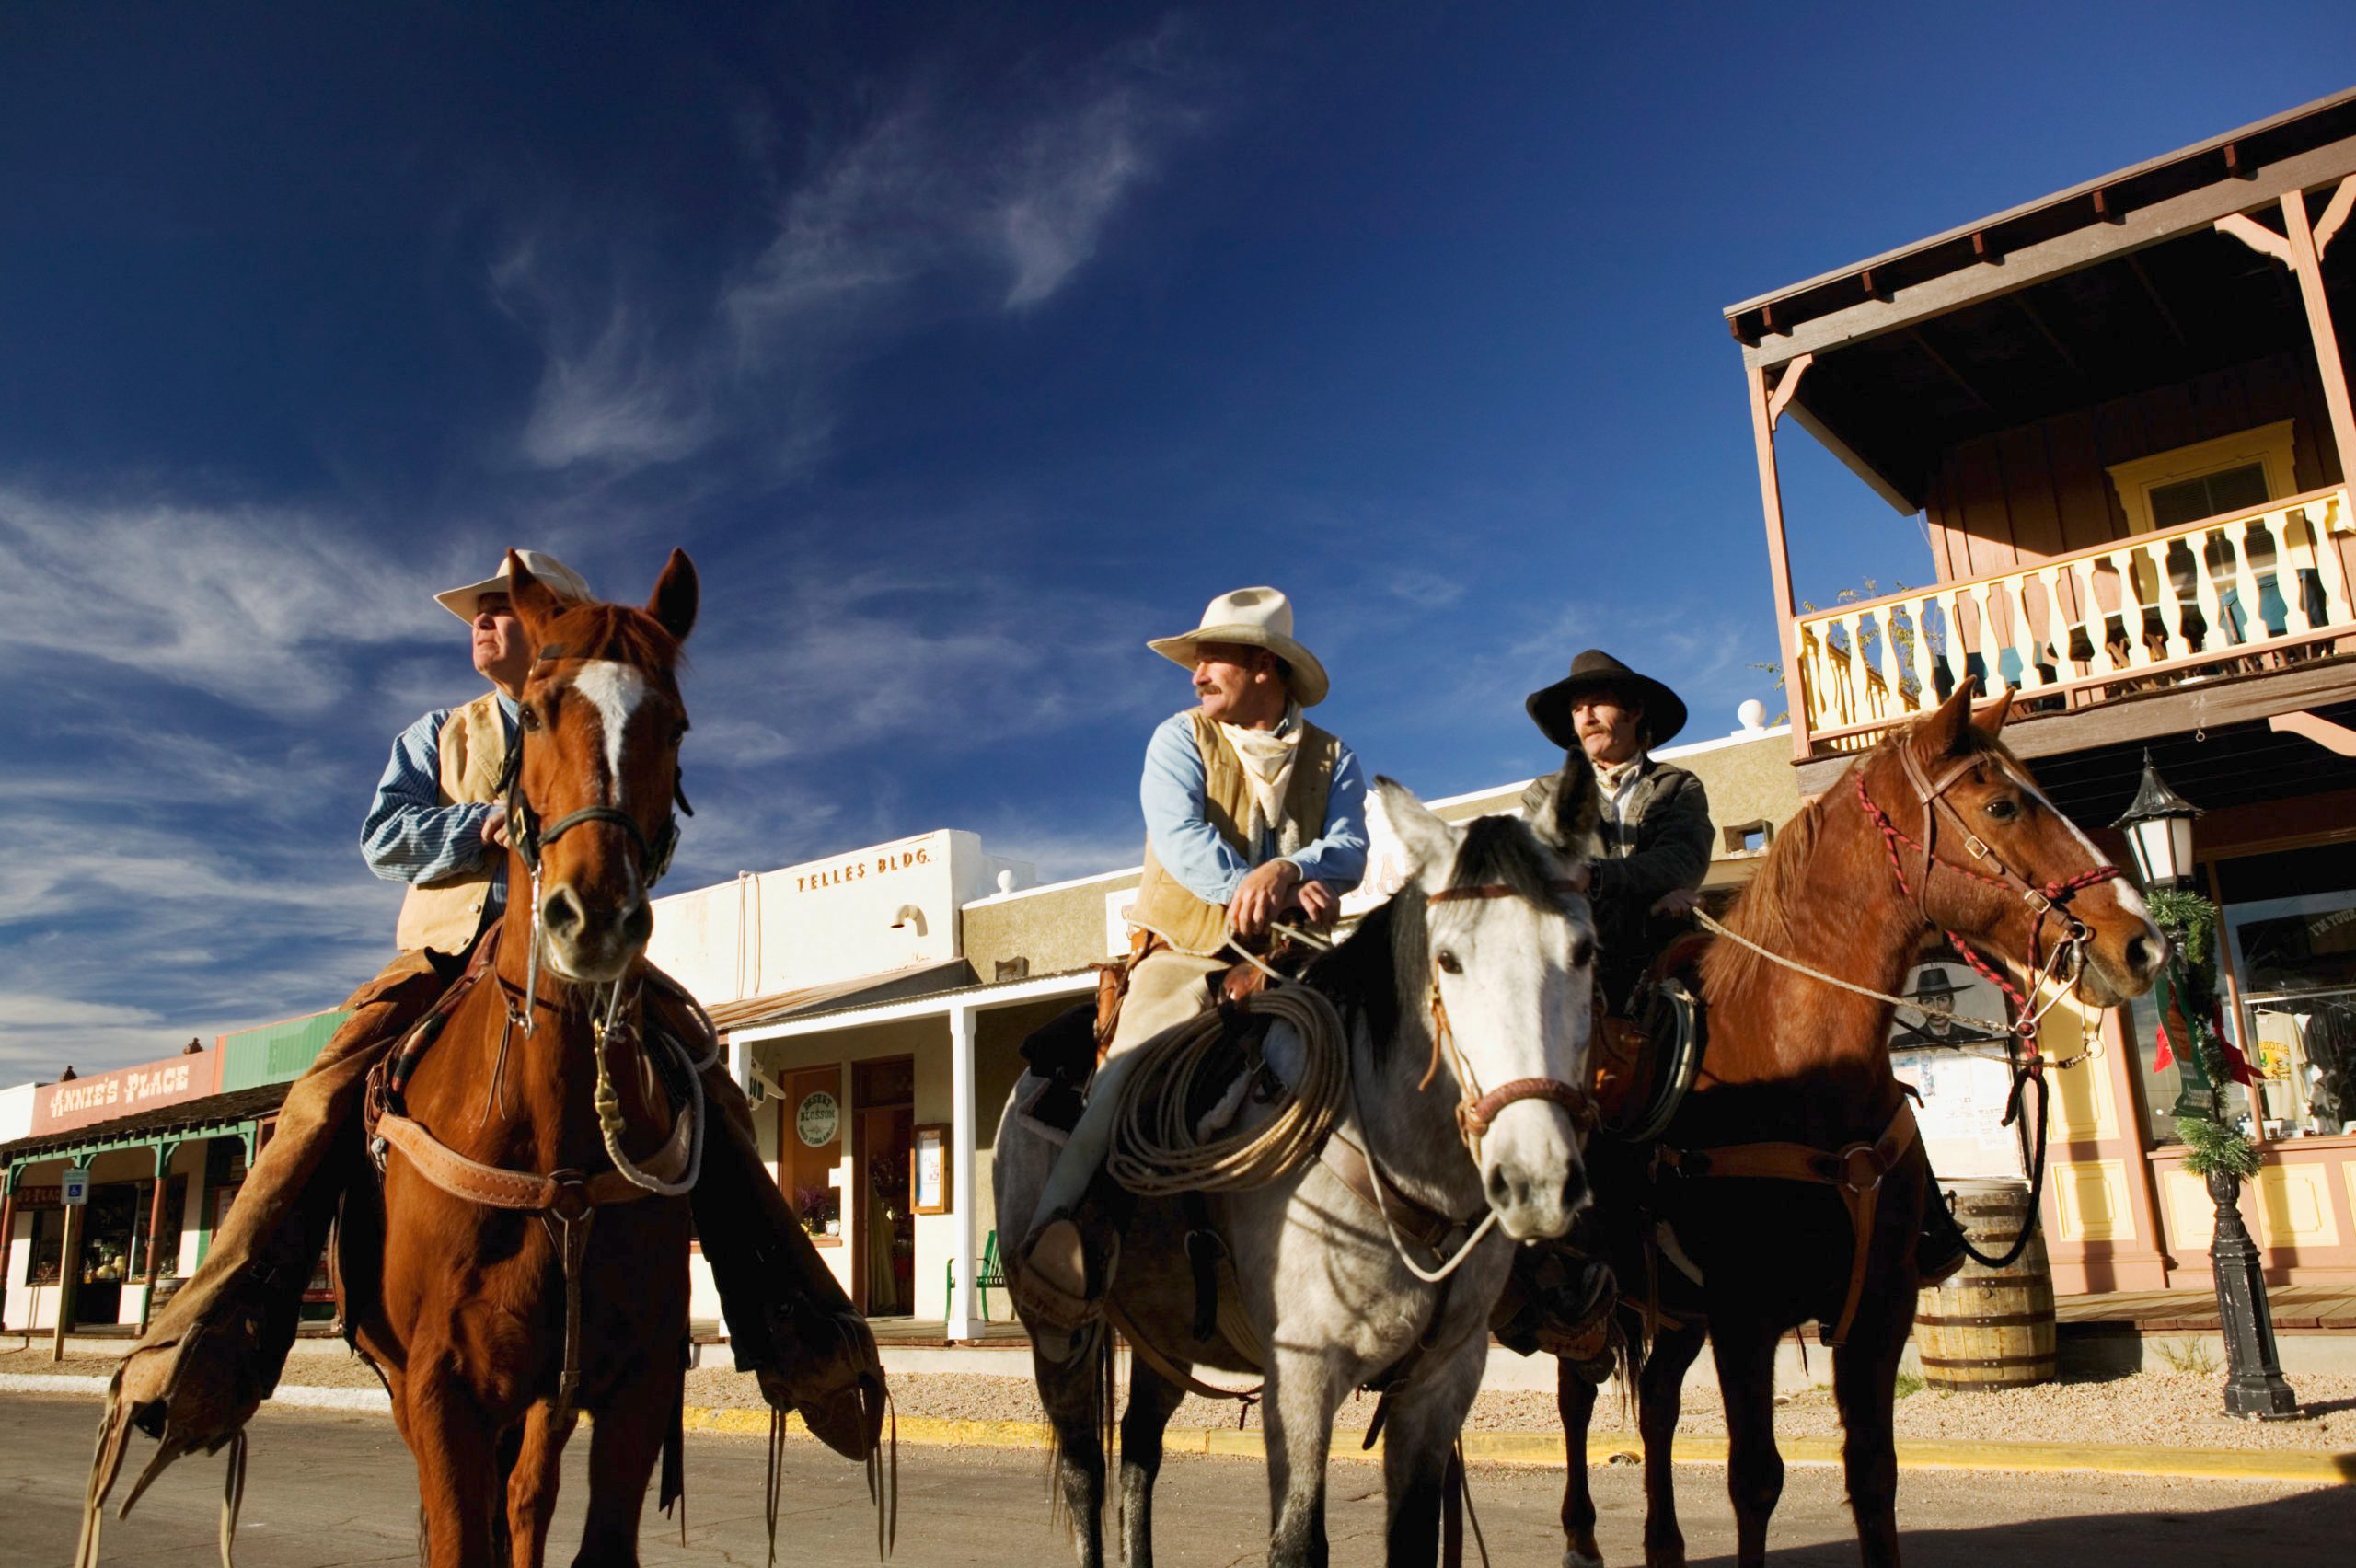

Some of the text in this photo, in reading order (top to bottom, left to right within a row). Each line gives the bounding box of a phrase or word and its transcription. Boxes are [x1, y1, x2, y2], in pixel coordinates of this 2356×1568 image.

[797, 847, 931, 893] TELLES BLDG.
[2308, 917, 2331, 937] I'M
[2258, 1041, 2290, 1056] izona
[50, 1065, 190, 1119] ANNIE'S PLACE
[800, 1109, 836, 1122] BLOSSOM
